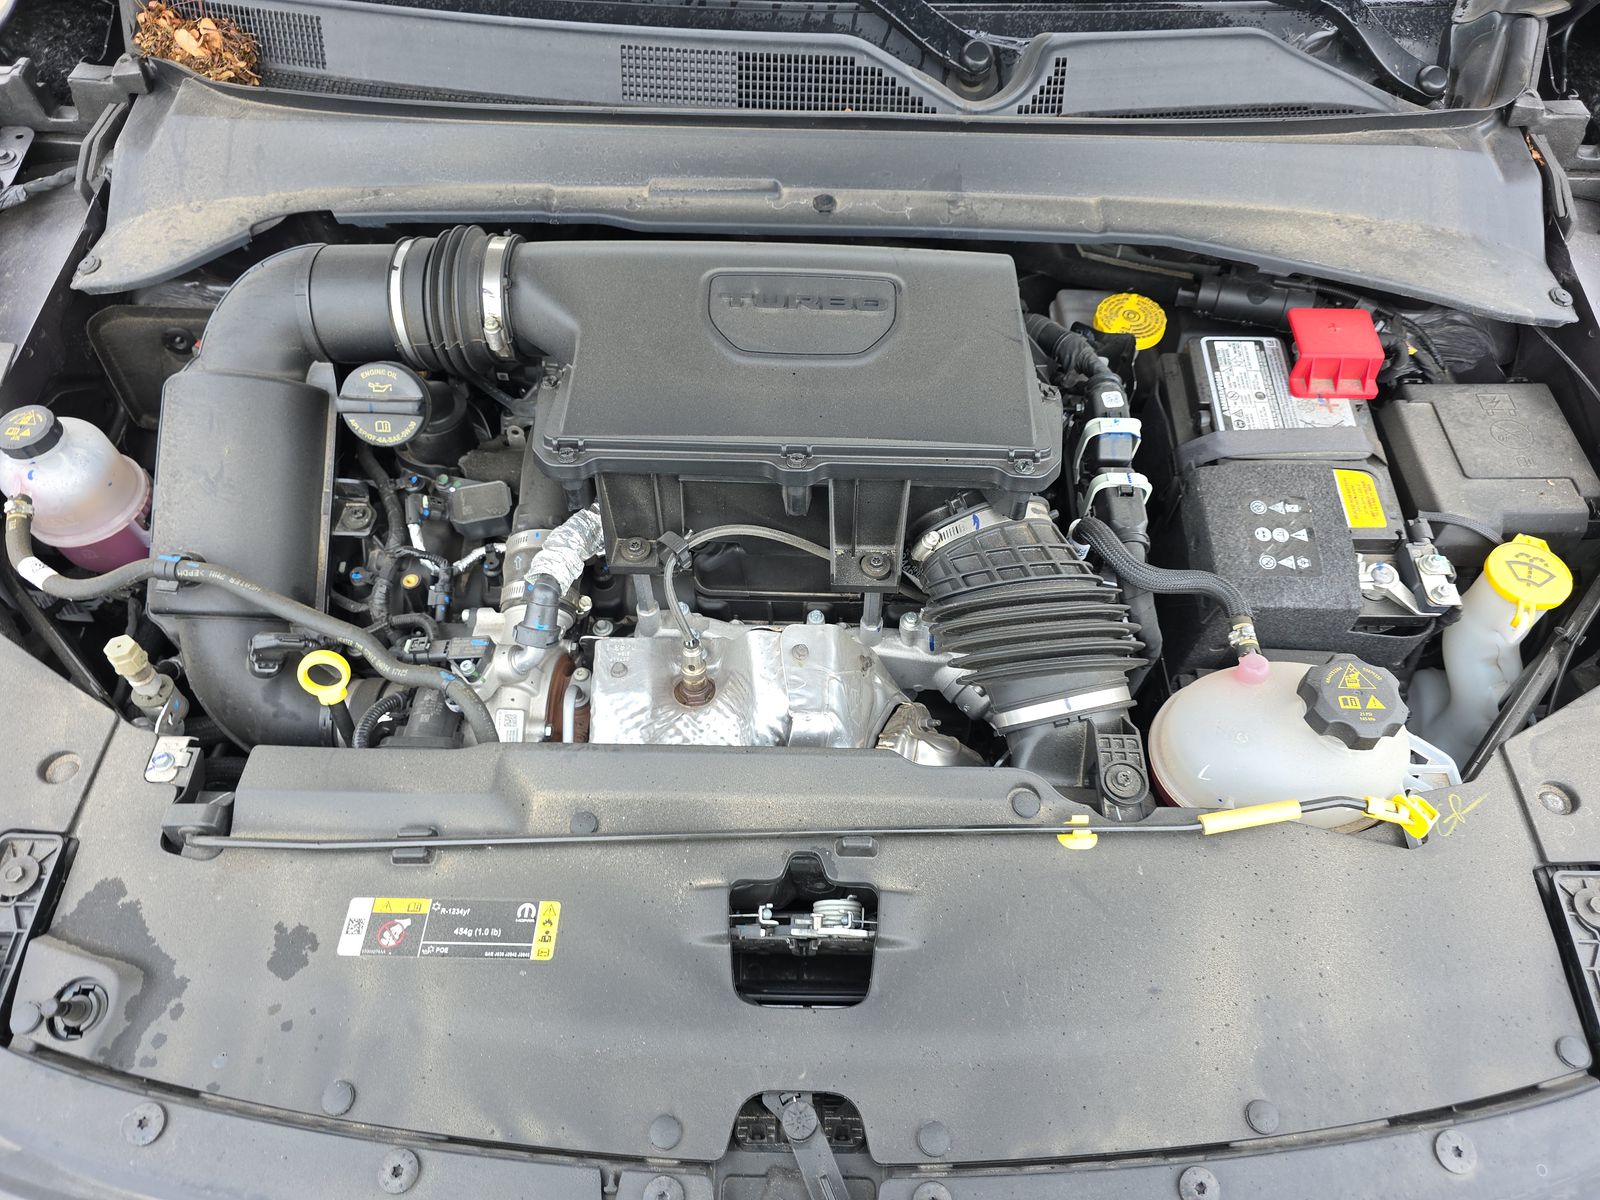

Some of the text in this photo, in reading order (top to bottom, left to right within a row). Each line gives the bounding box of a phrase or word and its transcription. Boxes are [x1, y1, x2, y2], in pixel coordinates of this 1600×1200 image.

[719, 291, 888, 314] TURBO
[360, 368, 398, 380] ENGINE OIL
[349, 419, 360, 430] API
[228, 576, 262, 592] HEATER
[440, 907, 470, 916] R-1234yf
[453, 926, 502, 938] 454g (1.0 lb)
[435, 946, 449, 954] POE
